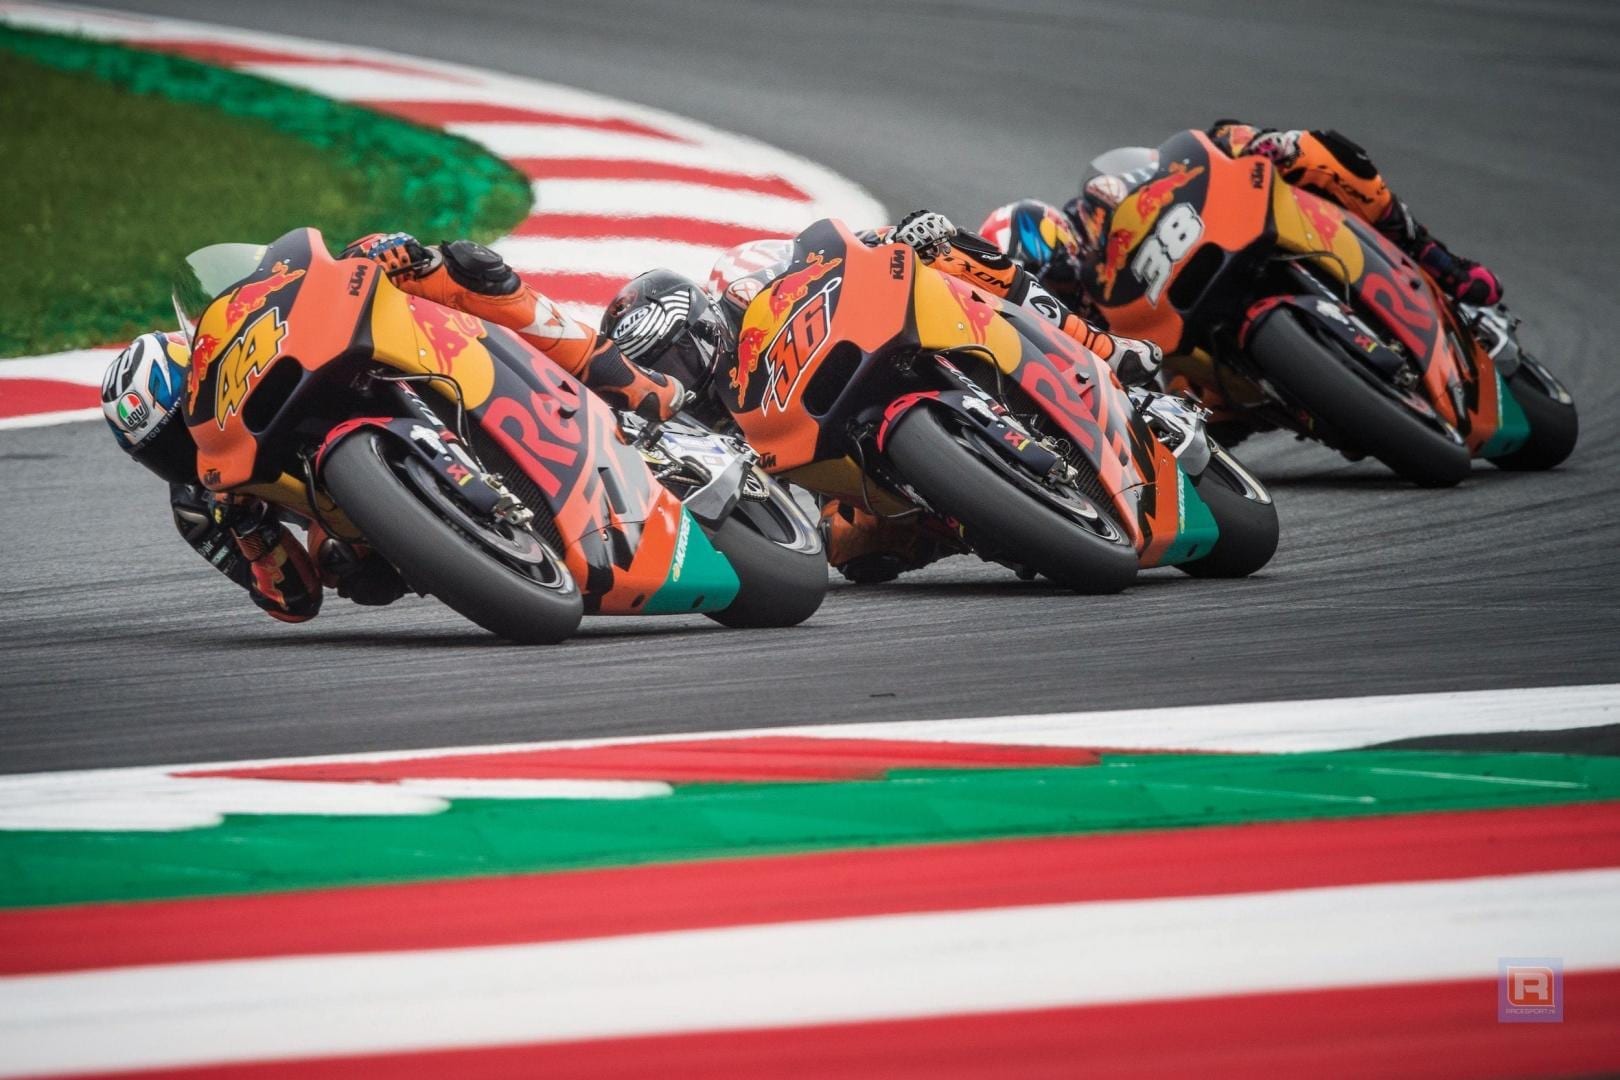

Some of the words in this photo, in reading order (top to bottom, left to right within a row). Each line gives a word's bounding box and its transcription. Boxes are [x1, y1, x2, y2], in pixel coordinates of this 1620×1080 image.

[1252, 162, 1265, 189] KTM
[890, 250, 906, 281] KTM
[1131, 202, 1206, 310] 38
[349, 264, 369, 296] KTM
[761, 279, 839, 416] 36
[214, 306, 289, 431] 44
[126, 405, 144, 426] agv
[759, 452, 777, 469] TM
